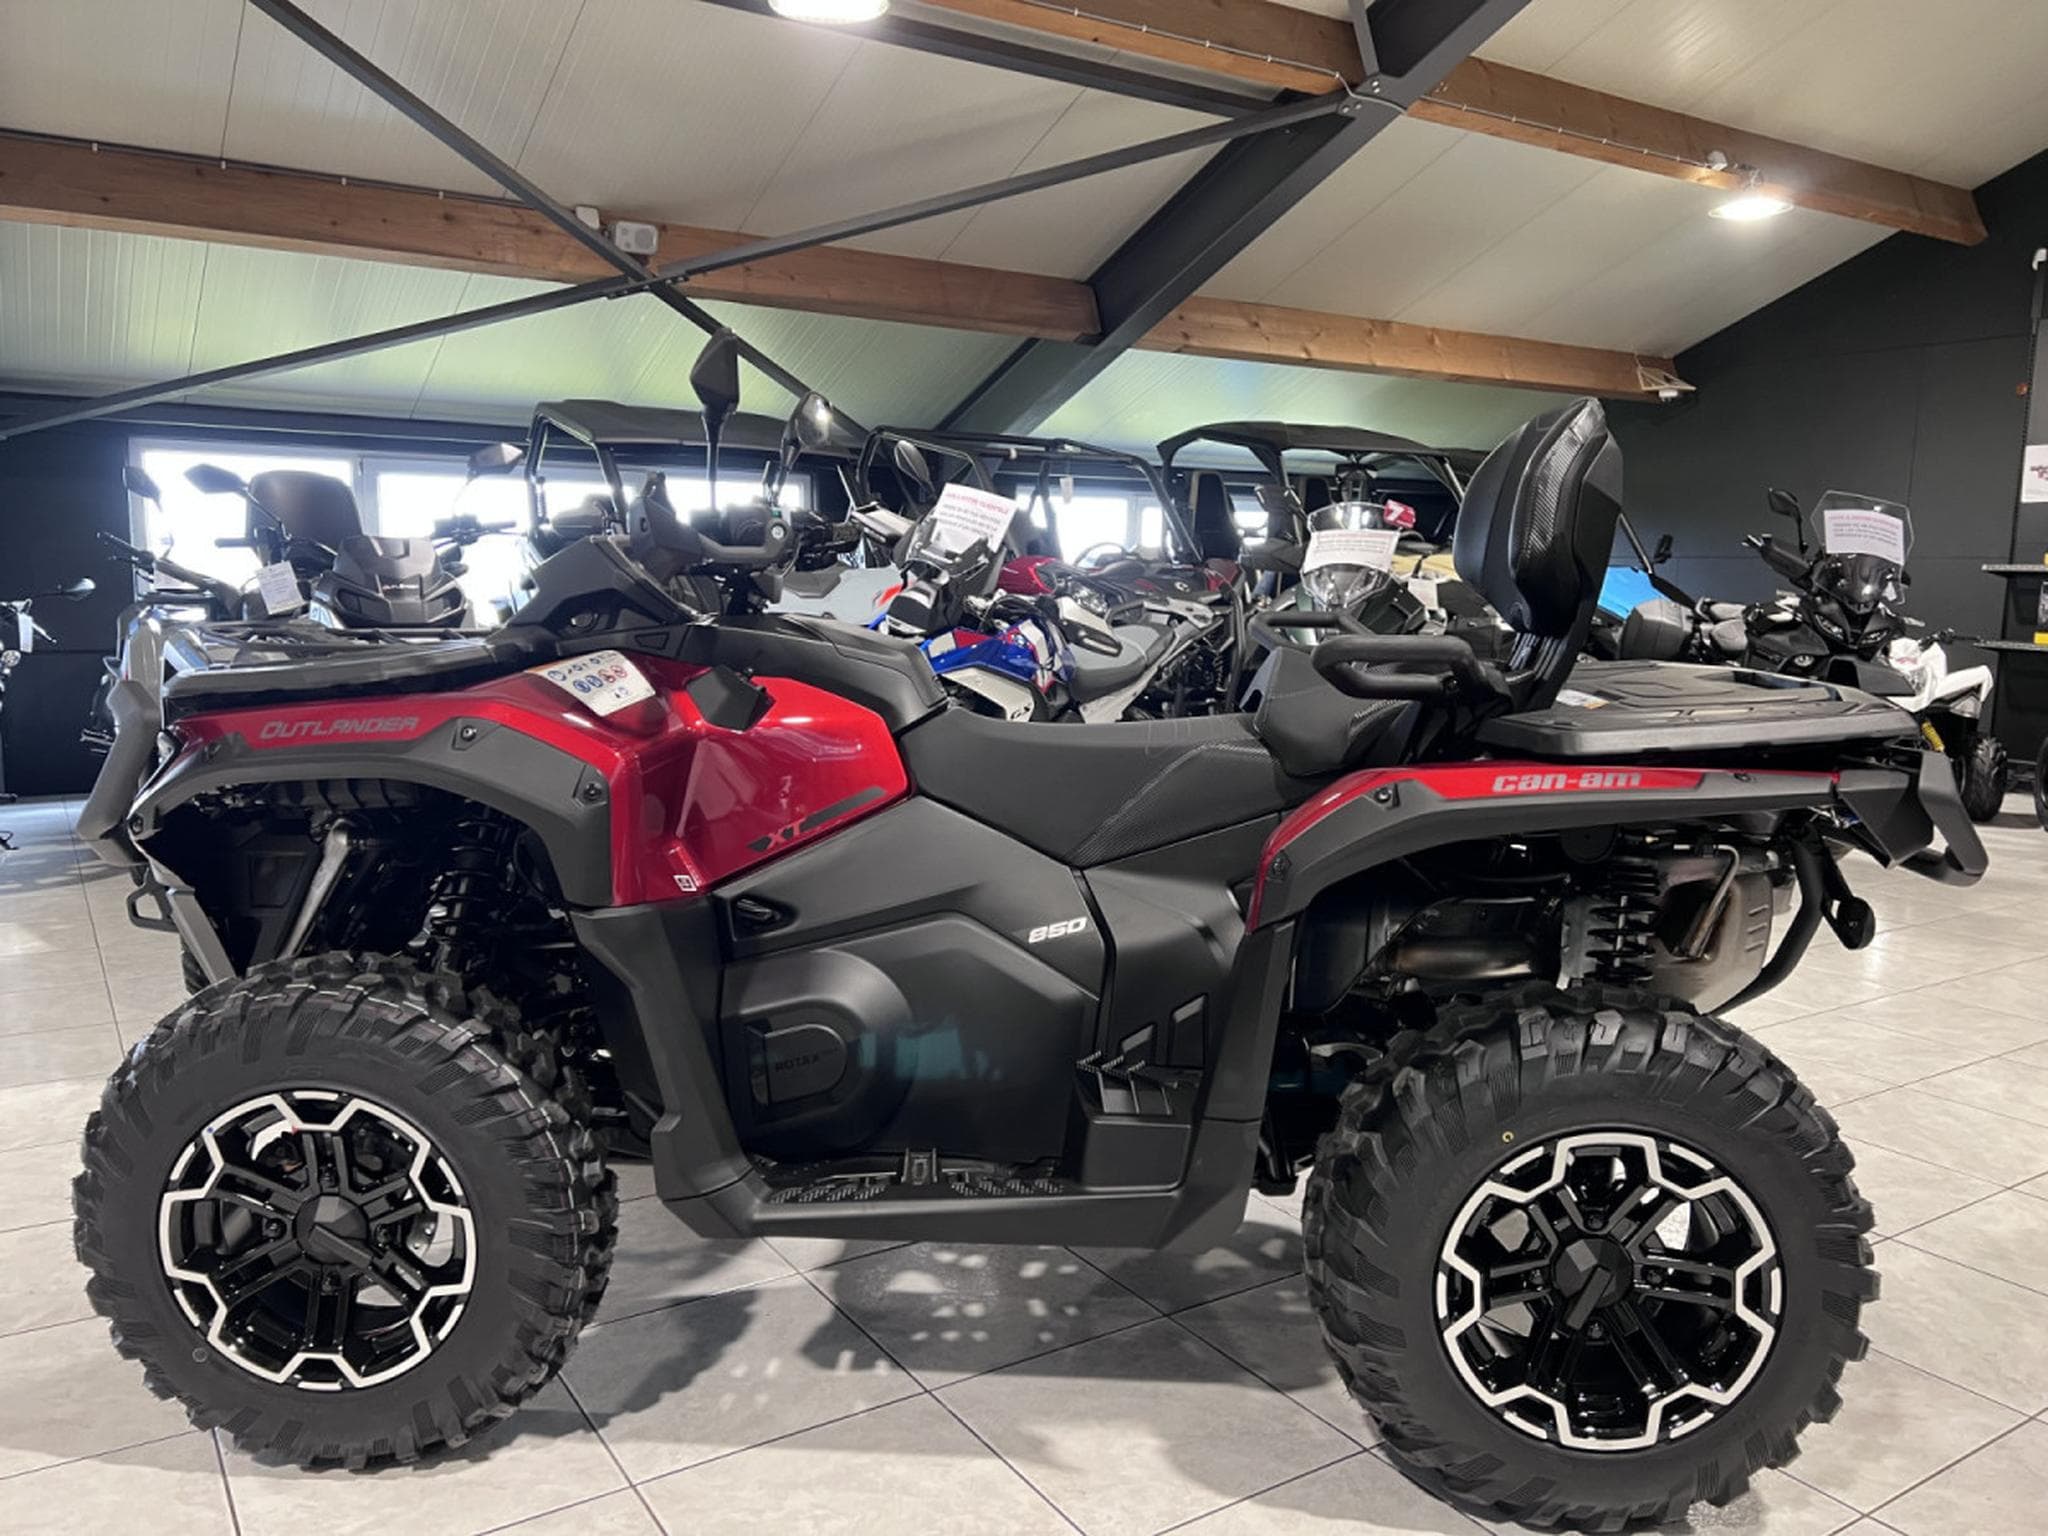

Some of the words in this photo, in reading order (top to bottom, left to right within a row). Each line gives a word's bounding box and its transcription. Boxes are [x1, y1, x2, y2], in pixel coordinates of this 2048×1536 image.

[260, 716, 419, 739] OUTLANDER
[1492, 772, 1642, 792] can-am
[1028, 916, 1087, 943] 850
